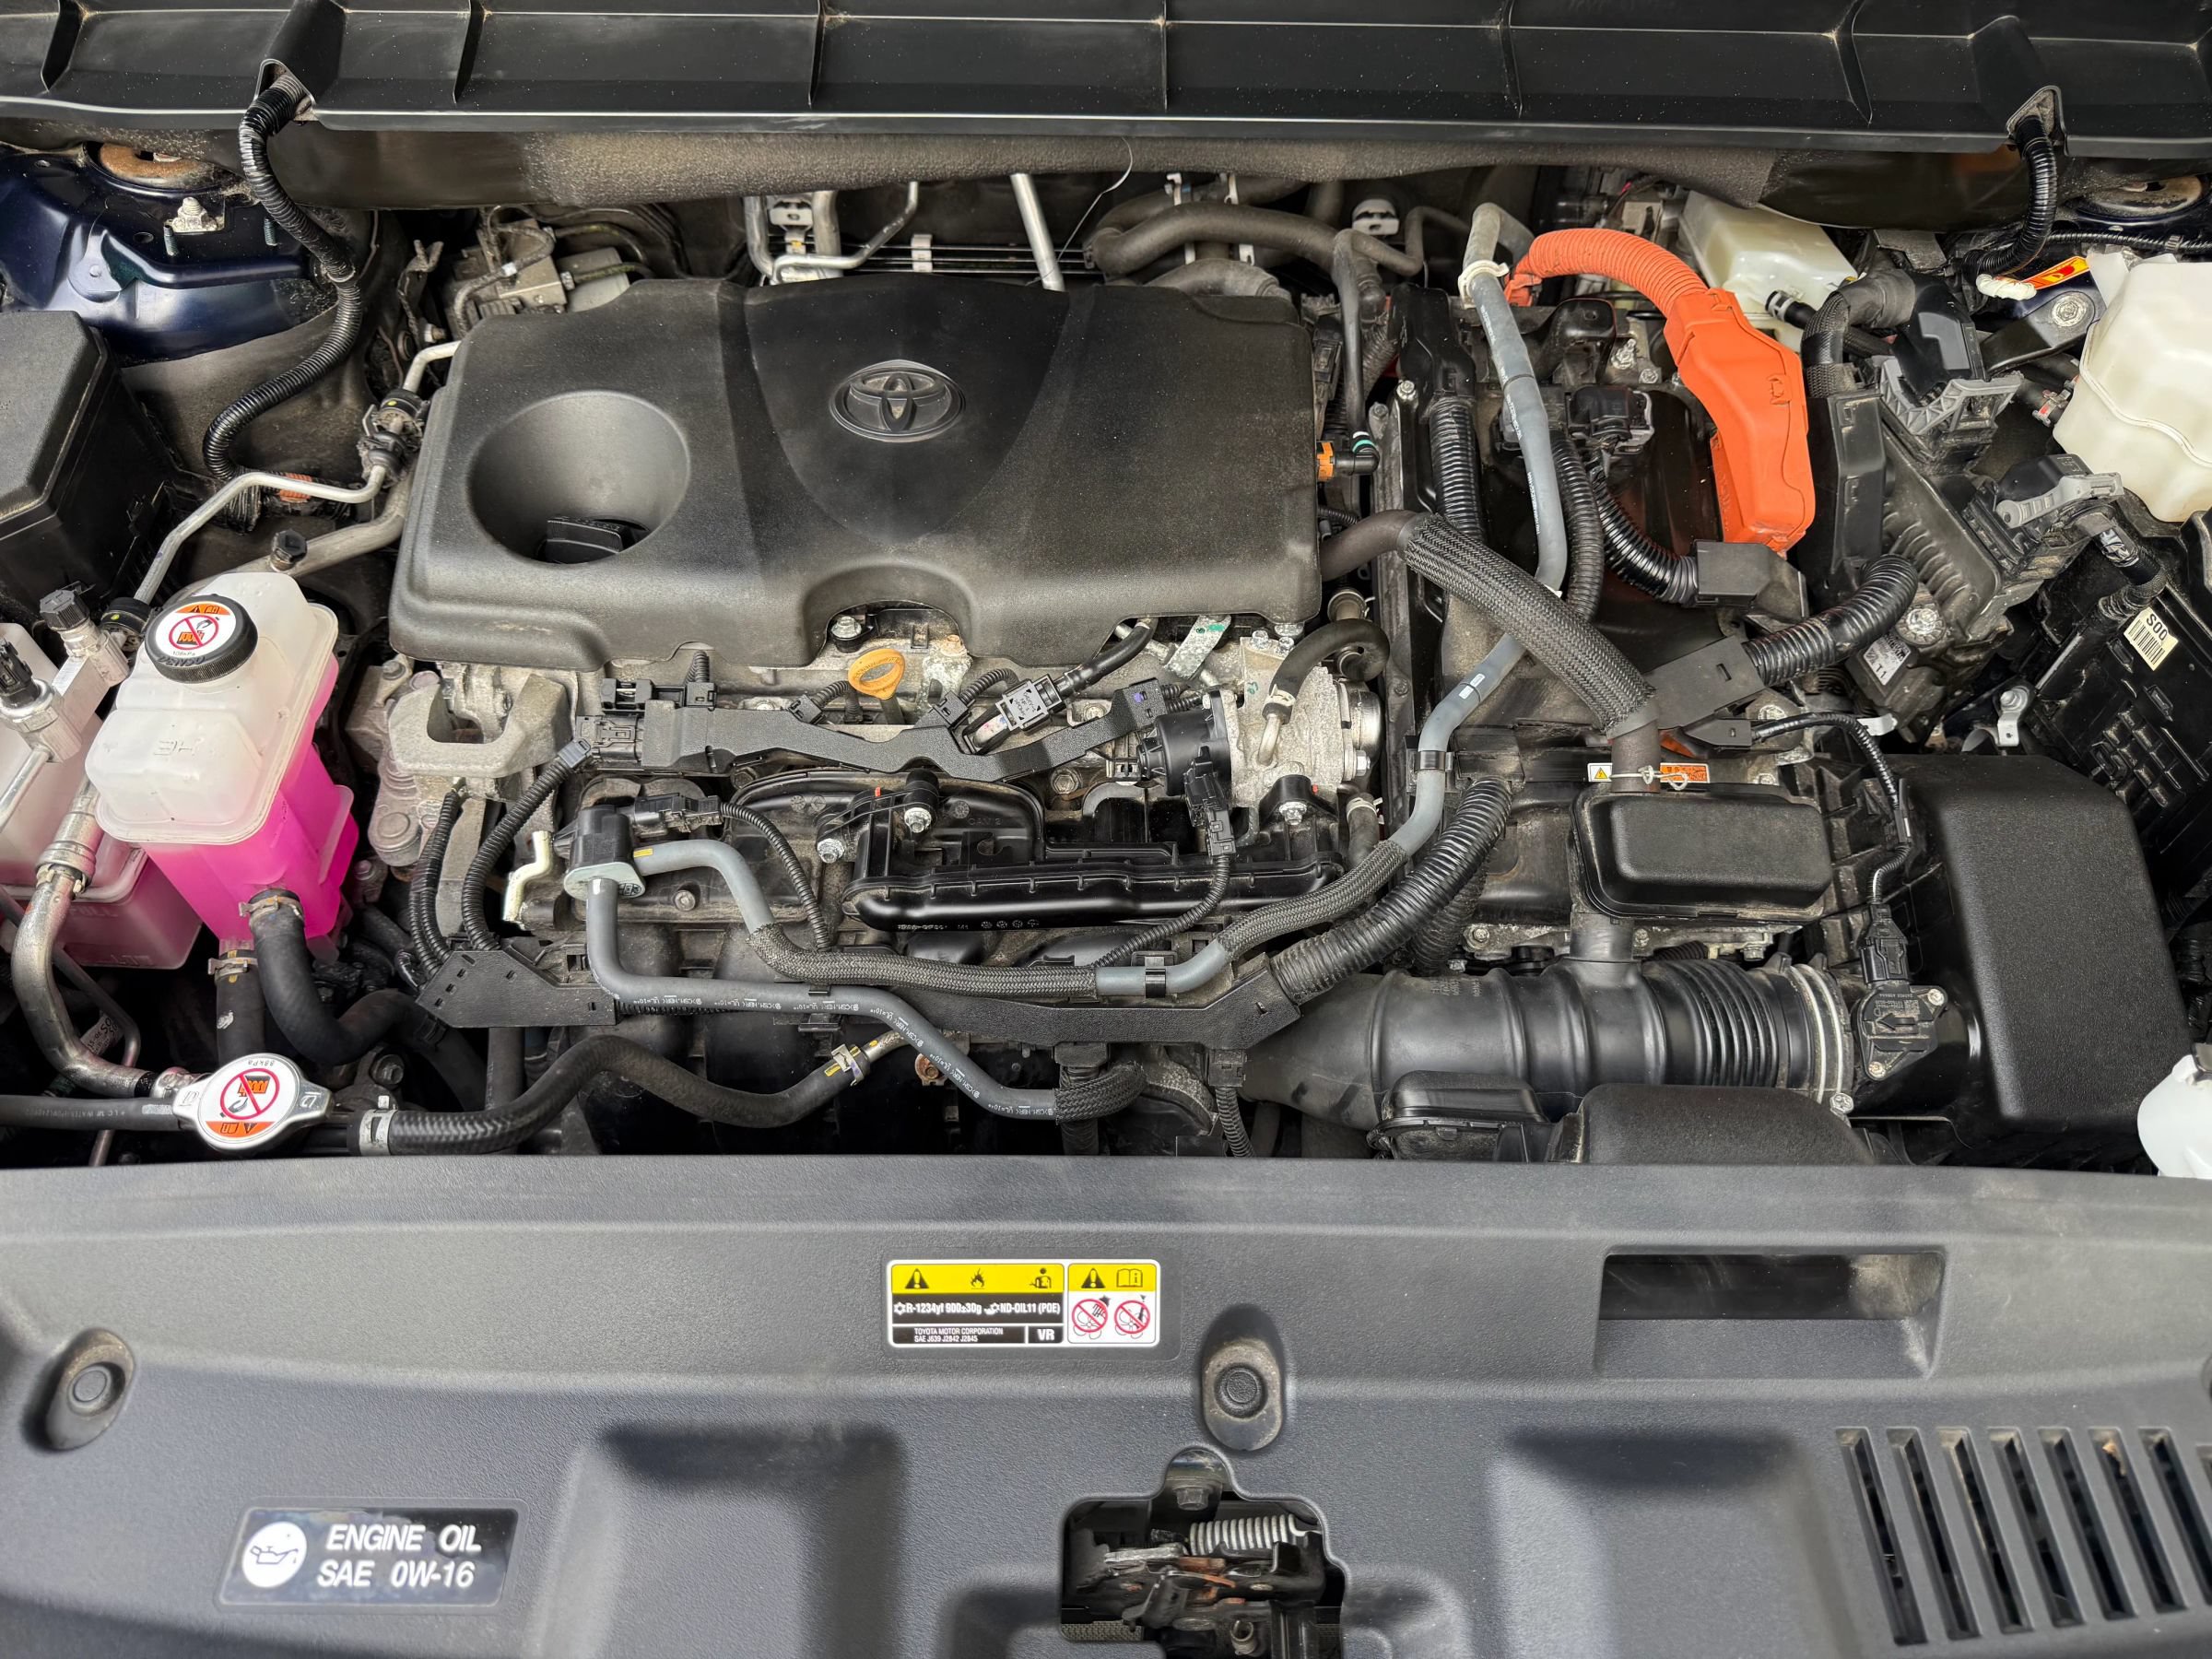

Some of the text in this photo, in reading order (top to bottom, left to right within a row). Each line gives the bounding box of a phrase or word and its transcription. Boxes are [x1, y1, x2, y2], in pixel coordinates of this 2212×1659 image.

[906, 1302, 944, 1315] R-1234yf
[946, 1302, 982, 1315] 900±30g
[1038, 1302, 1061, 1315] (POE)
[926, 1335, 941, 1343] J639
[1037, 1328, 1055, 1341] VR
[326, 1524, 482, 1553] ENGINE OIL
[316, 1559, 476, 1589] SAE 0W-16
